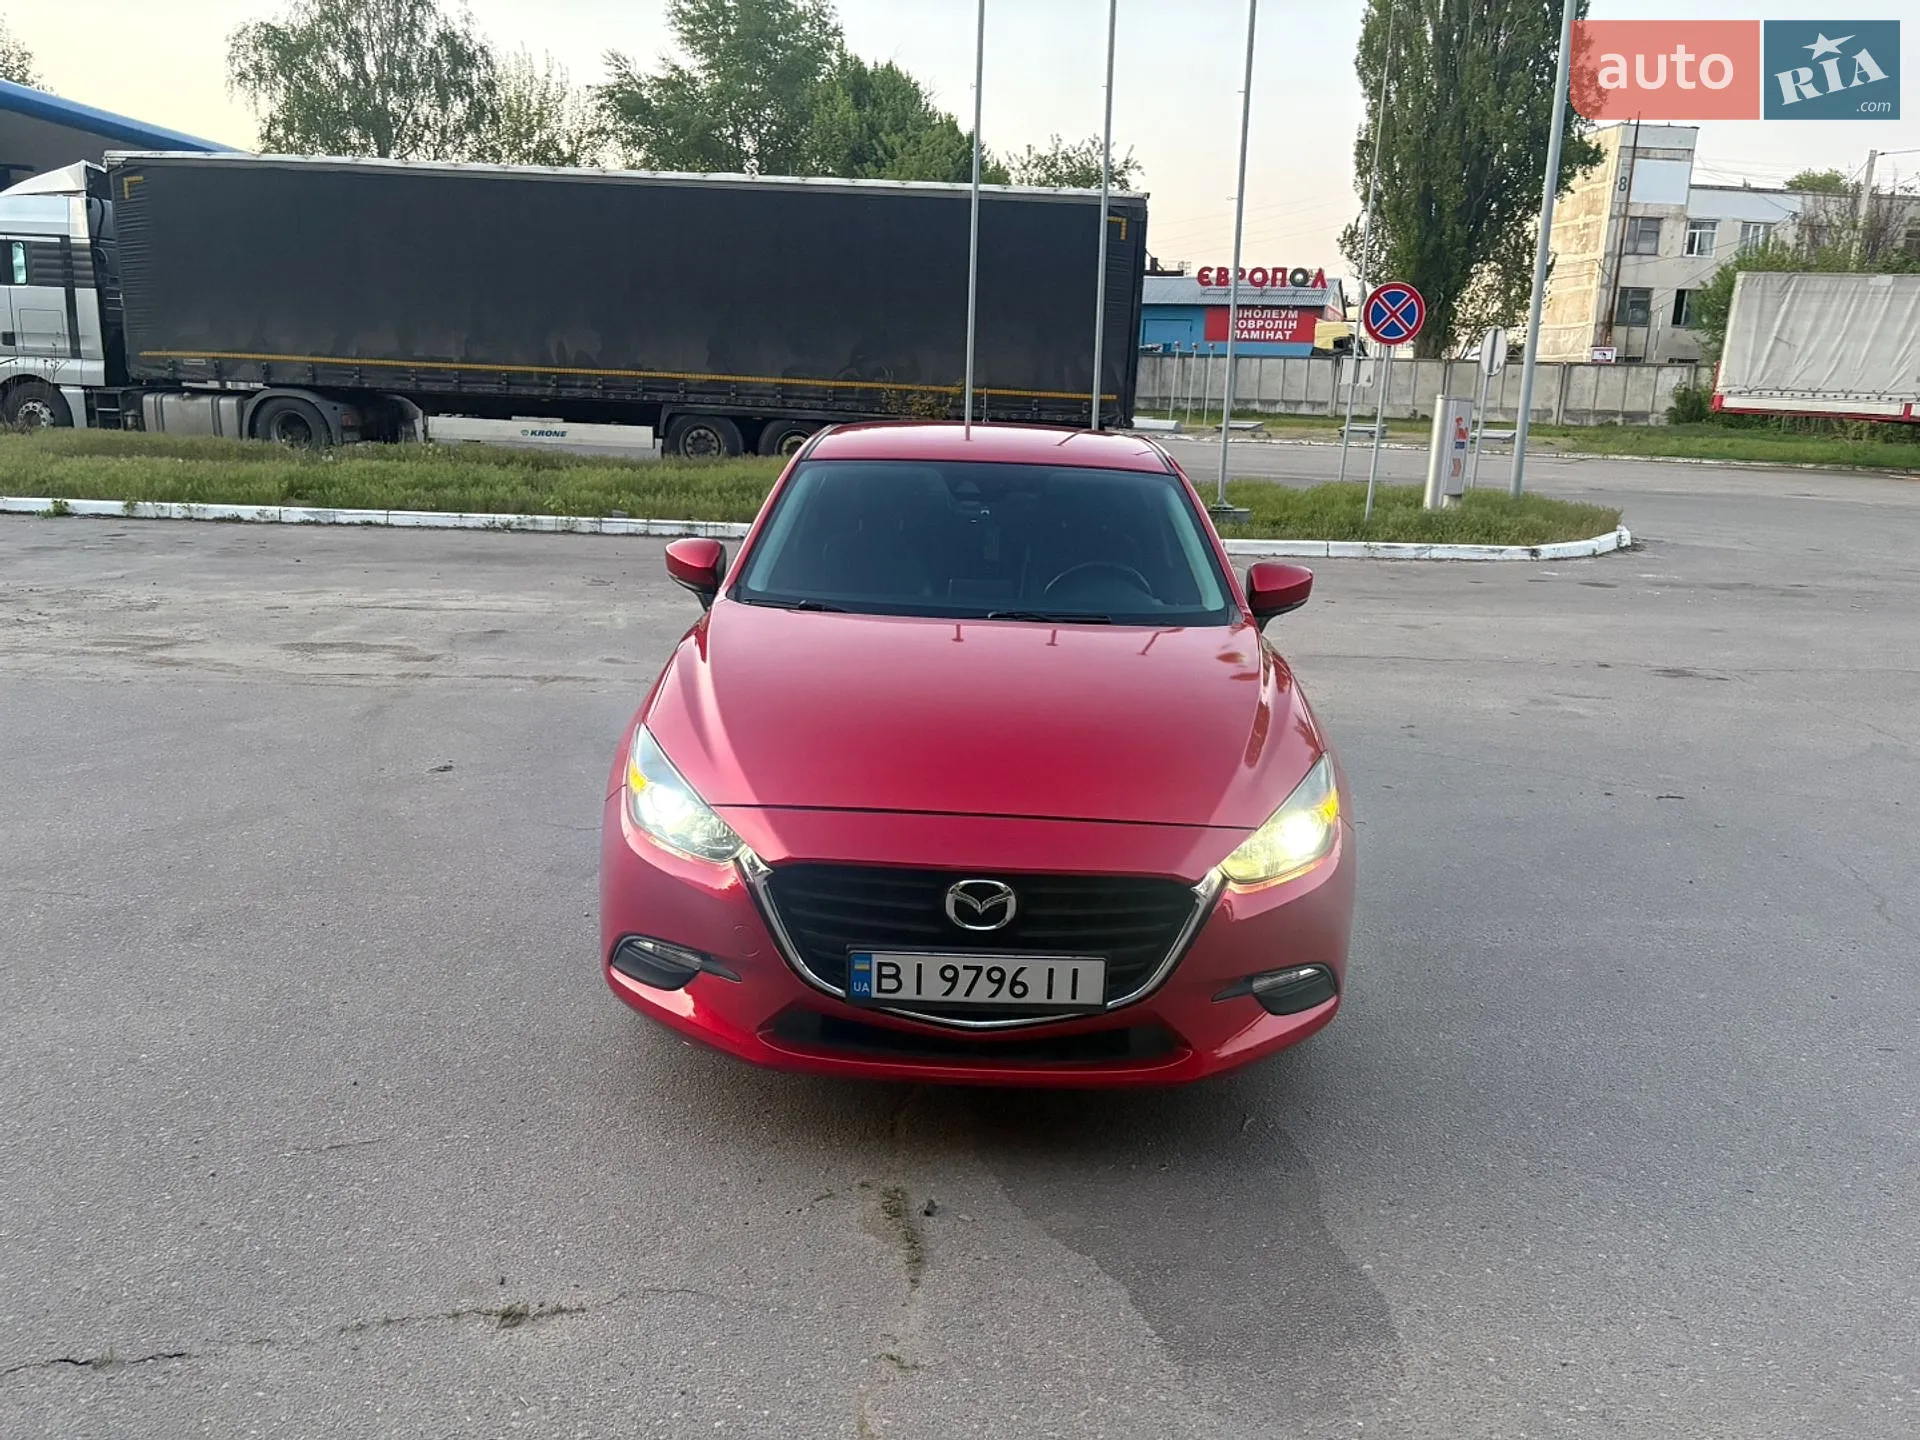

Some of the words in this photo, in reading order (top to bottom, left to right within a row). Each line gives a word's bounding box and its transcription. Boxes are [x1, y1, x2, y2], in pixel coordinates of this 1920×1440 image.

[1618, 176, 1627, 191] 8
[1235, 320, 1297, 329] ОВРОЛІН
[530, 429, 568, 437] KRONE
[853, 981, 870, 993] UA
[877, 962, 923, 996] BI
[939, 964, 1029, 998] 9796
[1046, 967, 1079, 1000] II
